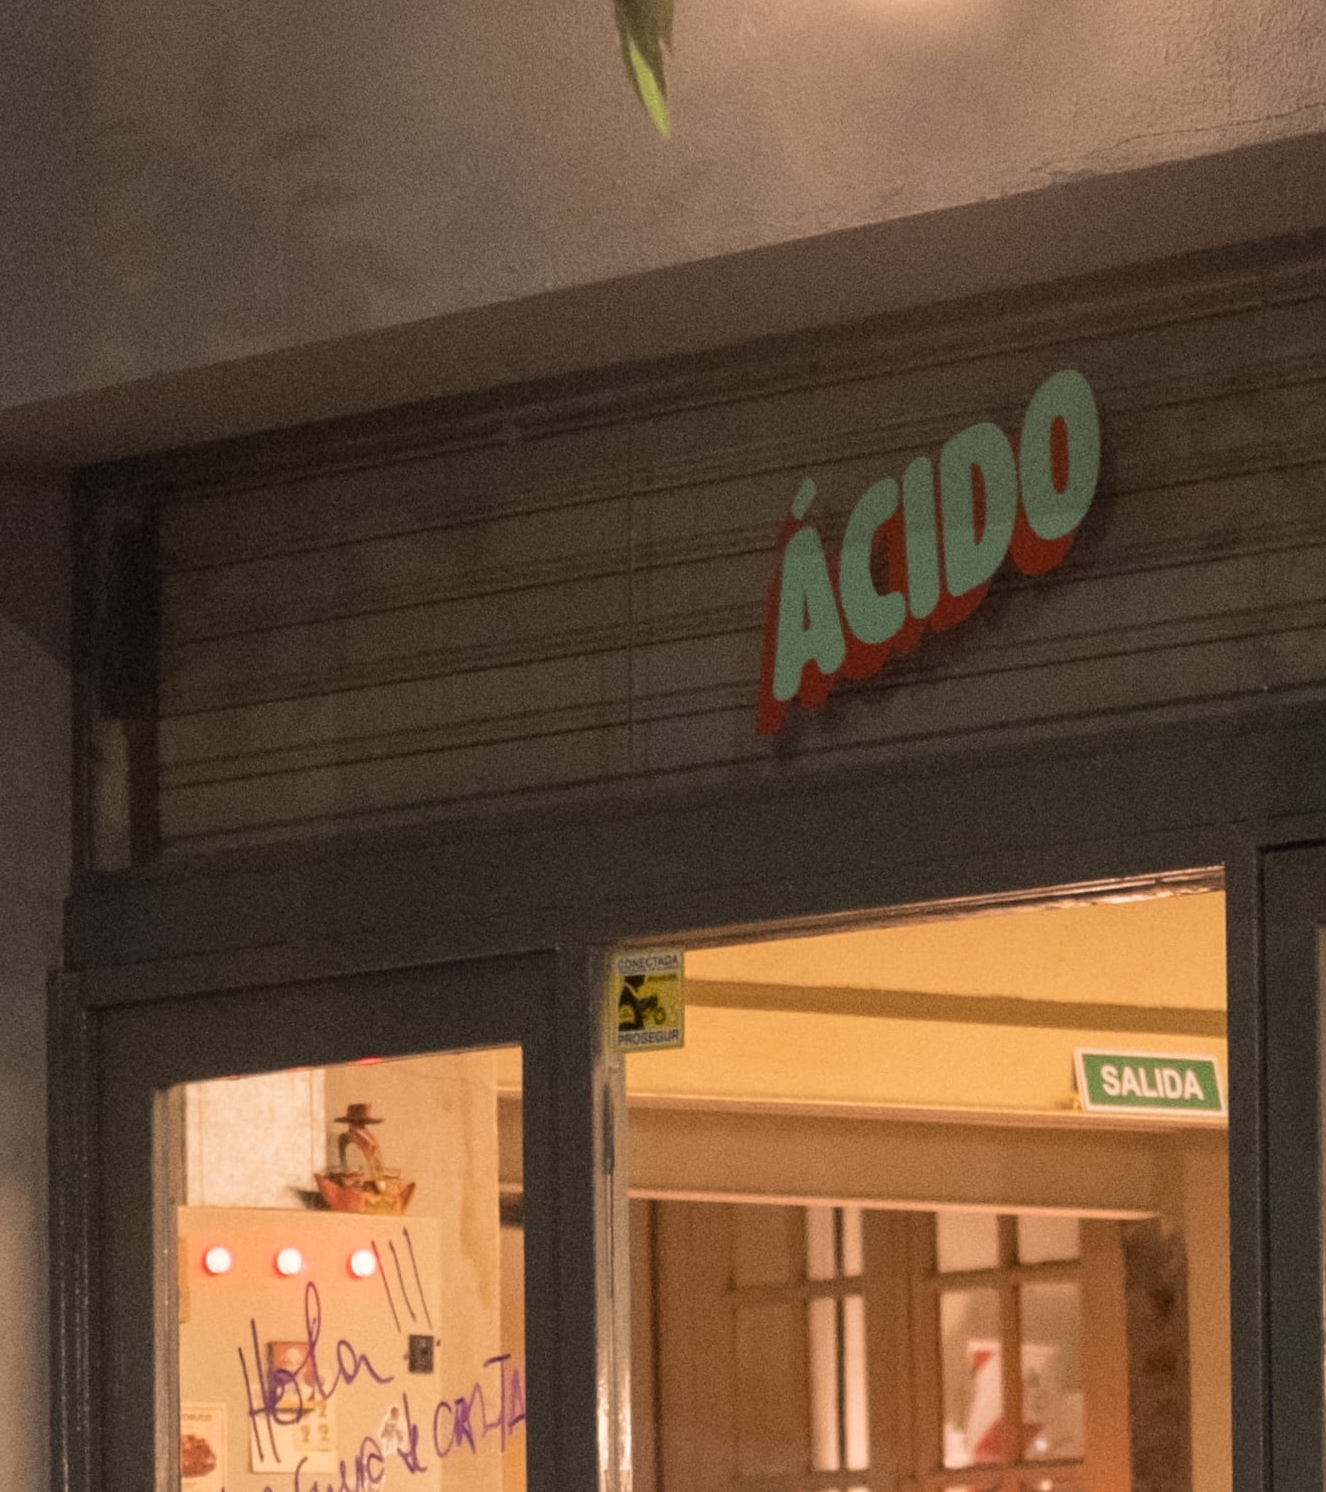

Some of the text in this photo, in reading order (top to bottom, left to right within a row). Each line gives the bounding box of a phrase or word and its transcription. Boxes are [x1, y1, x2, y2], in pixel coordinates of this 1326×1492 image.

[757, 369, 1101, 734] ÁCIDO
[618, 1029, 679, 1045] PROSEGUR
[1100, 1064, 1205, 1100] SALIDA
